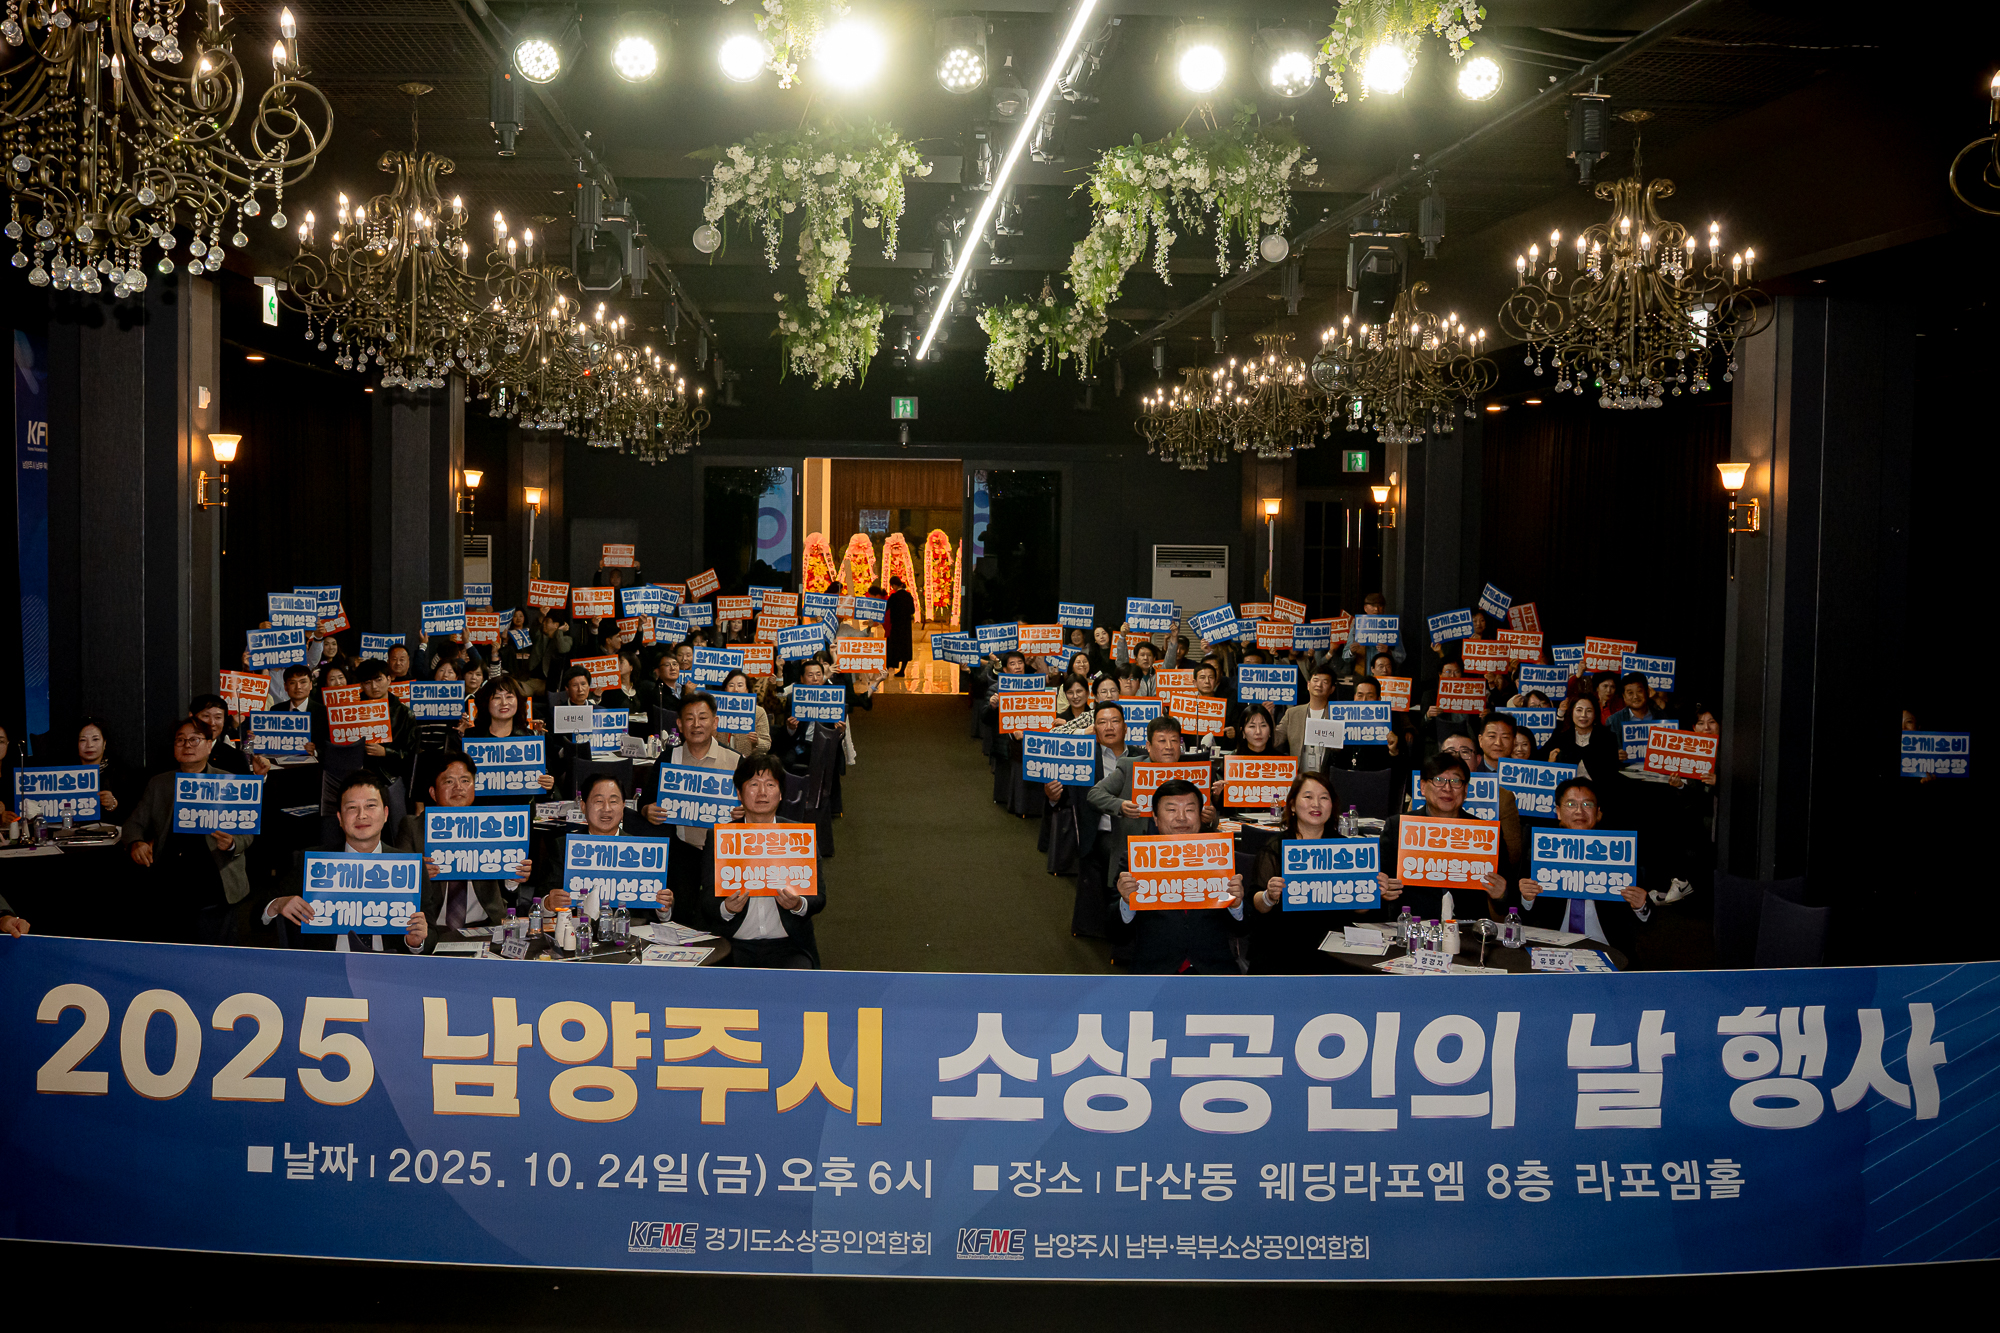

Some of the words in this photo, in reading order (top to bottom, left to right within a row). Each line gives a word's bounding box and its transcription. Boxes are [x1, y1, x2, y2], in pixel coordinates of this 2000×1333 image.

[27, 420, 48, 446] KF
[272, 597, 314, 610] 함께소비
[424, 603, 463, 617] 함께소비
[626, 601, 659, 614] 함께성장
[1276, 600, 1304, 614] 지갑활짝
[272, 614, 316, 627] 함께성장
[424, 619, 464, 632] 함께성장
[1128, 617, 1171, 630] 함께성장
[1200, 612, 1233, 629] 함께소비
[1430, 612, 1470, 626] 함께소비
[252, 632, 302, 648] 함께소비
[780, 627, 821, 642] 함께소비
[979, 626, 1016, 639] 함께소비
[1204, 623, 1239, 642] 함께성장
[1433, 626, 1472, 642] 함께성장
[979, 640, 1017, 654] 함께성장
[252, 649, 304, 666] 함께성장
[696, 651, 741, 666] 함께소비
[1626, 659, 1672, 672] 함께소비
[743, 662, 771, 673] 생활짝
[1242, 669, 1294, 682] 함께소비
[220, 676, 267, 694] 지갑활짝
[412, 685, 462, 699] 함께소비
[1241, 686, 1294, 701] 함께성장
[717, 696, 753, 711] 께소비
[796, 688, 842, 702] 함께소비
[331, 706, 386, 721] 지갑활짝
[795, 706, 842, 720] 함께성장
[1174, 700, 1223, 715] 지갑활짝
[1333, 706, 1388, 720] 함께소비
[254, 716, 307, 730] 함께소비
[593, 714, 626, 726] 께소비
[718, 715, 753, 730] 께성장
[1002, 716, 1054, 730] 인생활짝
[1177, 717, 1222, 732] 생활짝
[1516, 714, 1553, 726] 께소비
[254, 735, 308, 750] 함께성장
[1345, 727, 1389, 741] 께성장
[1027, 737, 1092, 758] 함께소비
[1651, 733, 1715, 755] 지갑활짝
[1902, 736, 1966, 752] 함께소비
[1026, 760, 1092, 782] 함께성장
[1228, 762, 1294, 779] 지갑활짝
[1649, 753, 1712, 774] 인생활짝
[1902, 758, 1967, 774] 함께성장
[19, 772, 96, 792] 함께소비
[180, 780, 258, 801] 함께소비
[664, 771, 737, 797] 함께소비
[20, 798, 96, 816] 께성장
[178, 808, 258, 829] 함께성장
[431, 815, 524, 839] 함께소비
[720, 833, 811, 855] 지갑활짝
[1405, 825, 1495, 851] 지갑활짝
[571, 843, 663, 869] 함께소비
[1134, 842, 1229, 868] 지갑활짝
[1538, 836, 1631, 862] 함께소비
[430, 849, 526, 873] 함께성장
[1288, 847, 1375, 870] 함께소비
[311, 862, 415, 889] 함께소비
[720, 866, 812, 890] 인생활짝
[1537, 868, 1632, 894] 함께성장
[1136, 877, 1230, 902] 인생활짝
[1288, 880, 1376, 904] 함께성장
[309, 900, 417, 926] 함께성장
[35, 984, 374, 1107] 2025
[422, 997, 884, 1128] 남양주시
[930, 1011, 1522, 1135] 소상공인의
[1567, 1010, 1677, 1131] 날
[1716, 1003, 1948, 1130] 행사
[285, 1142, 360, 1182] 날짜
[389, 1149, 506, 1190] 2025.
[526, 1153, 585, 1192] 10.
[778, 1157, 859, 1198] 오후
[869, 1160, 933, 1200] 6시
[1009, 1161, 1084, 1199] 장소
[1116, 1163, 1238, 1203] 다산동
[1260, 1162, 1466, 1203] 웨딩라포엠
[1488, 1161, 1555, 1203] 8층
[1577, 1160, 1746, 1203] 라포엠홀
[630, 1221, 698, 1248] KFME
[705, 1227, 932, 1256] 경기도소상공인연합회
[957, 1228, 1027, 1255] KFME
[1034, 1234, 1119, 1260] 남양주시
[1126, 1235, 1370, 1261] 남부·북부소상공인연합회
